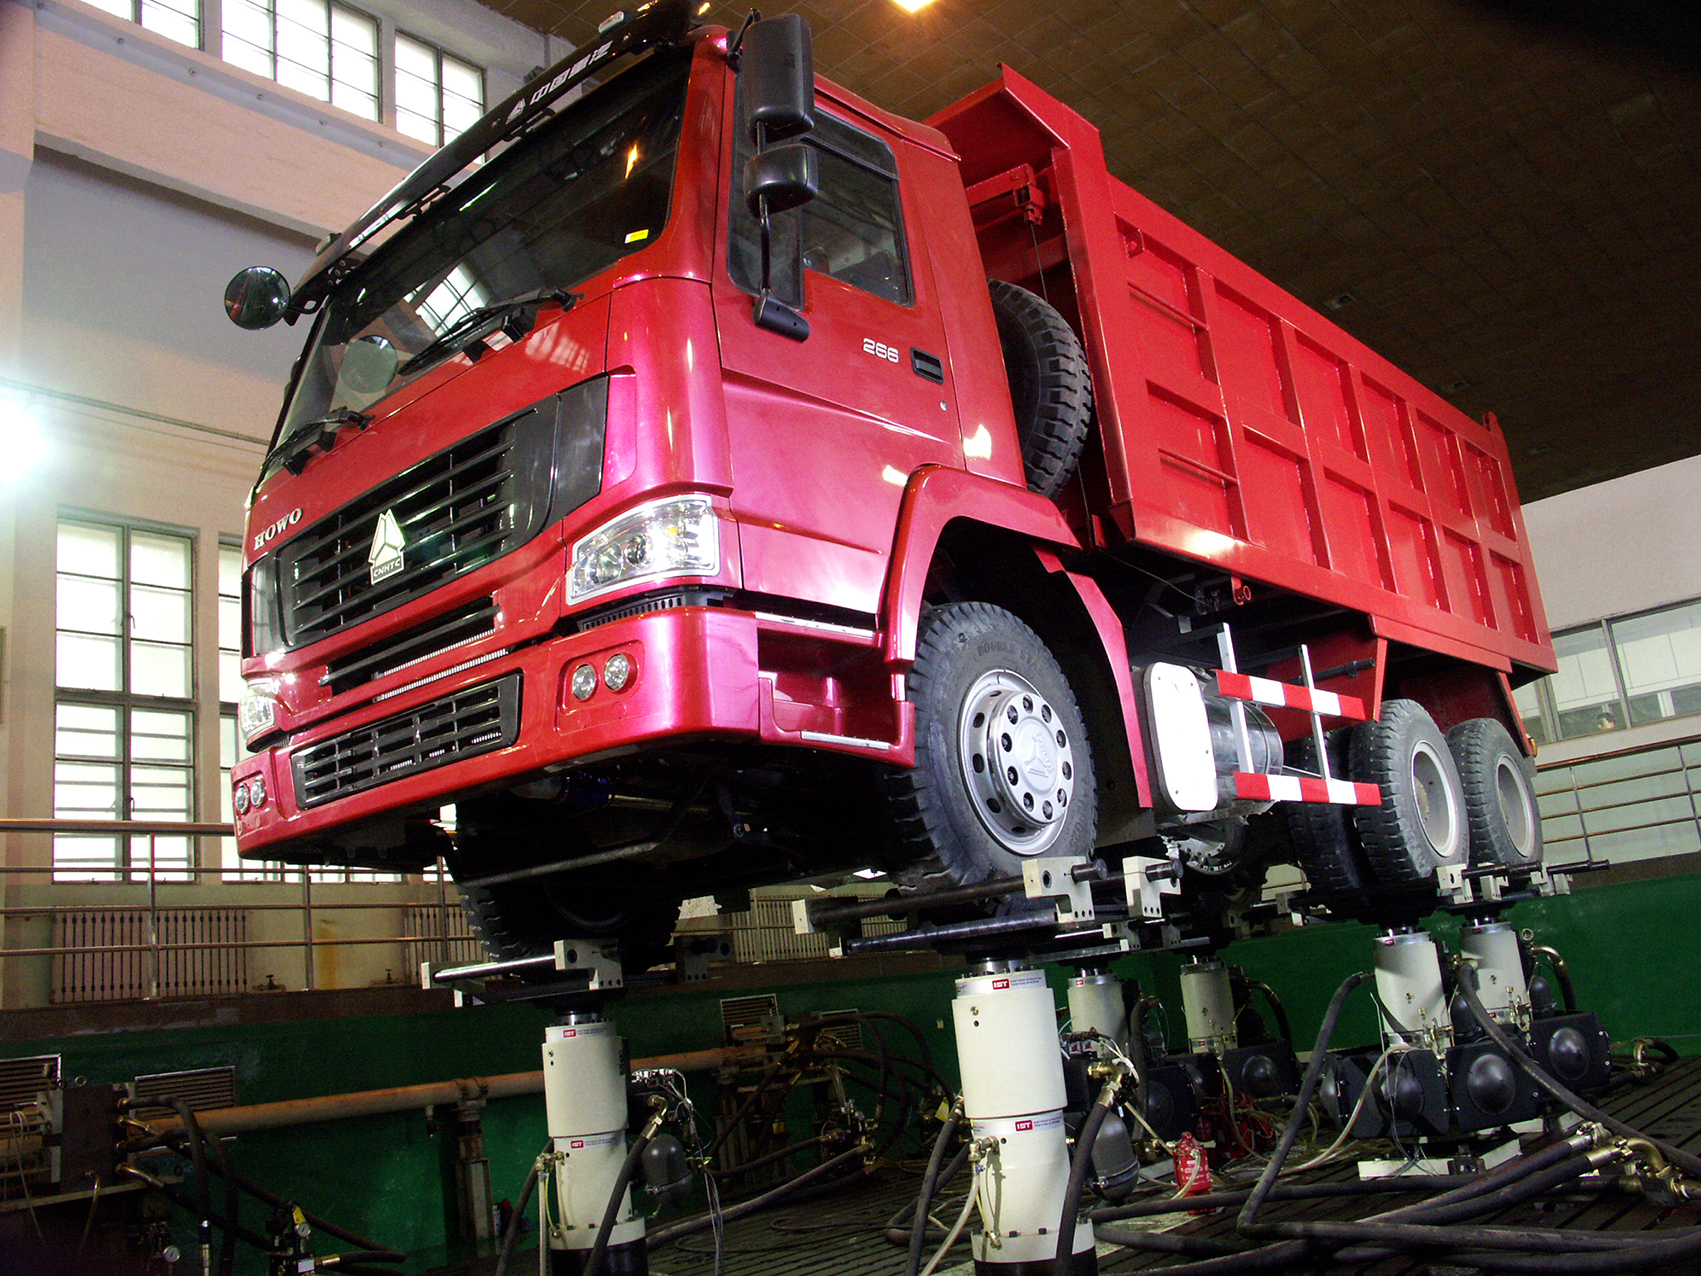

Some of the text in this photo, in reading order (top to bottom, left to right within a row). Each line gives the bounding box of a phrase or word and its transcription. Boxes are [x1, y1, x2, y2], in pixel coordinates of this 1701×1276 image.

[863, 338, 899, 363] 266
[254, 508, 303, 550] HOWO
[373, 559, 402, 578] CNHTC
